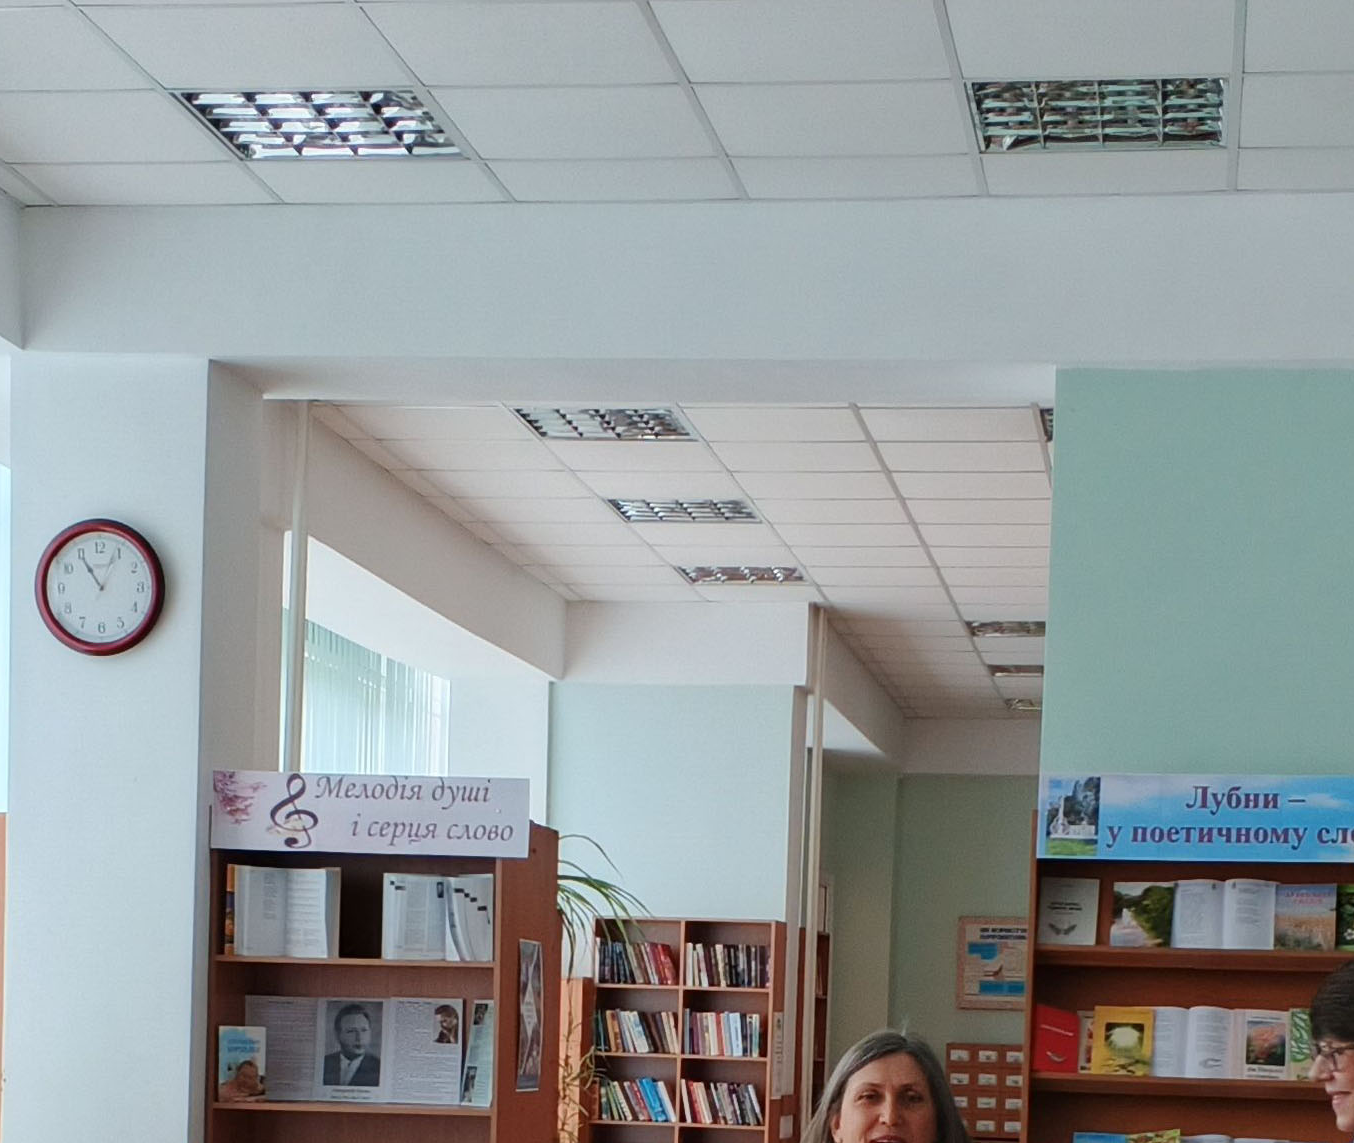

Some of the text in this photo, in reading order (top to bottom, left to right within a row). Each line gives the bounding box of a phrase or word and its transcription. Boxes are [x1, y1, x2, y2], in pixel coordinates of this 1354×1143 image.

[94, 541, 106, 554] 12
[116, 548, 121, 559] 1
[64, 563, 73, 574] 10
[131, 562, 138, 574] 2
[57, 583, 65, 594] 9
[136, 582, 145, 593] 3
[64, 603, 72, 614] 8
[131, 602, 138, 613] 4
[79, 616, 86, 629] 7
[98, 622, 106, 633] 6
[117, 617, 125, 629] 5
[315, 776, 491, 810] Мелодія душі
[1185, 785, 1279, 815] Лубни
[351, 813, 514, 846] і серця слово
[1106, 825, 1123, 849] у
[1131, 824, 1308, 850] поетичному
